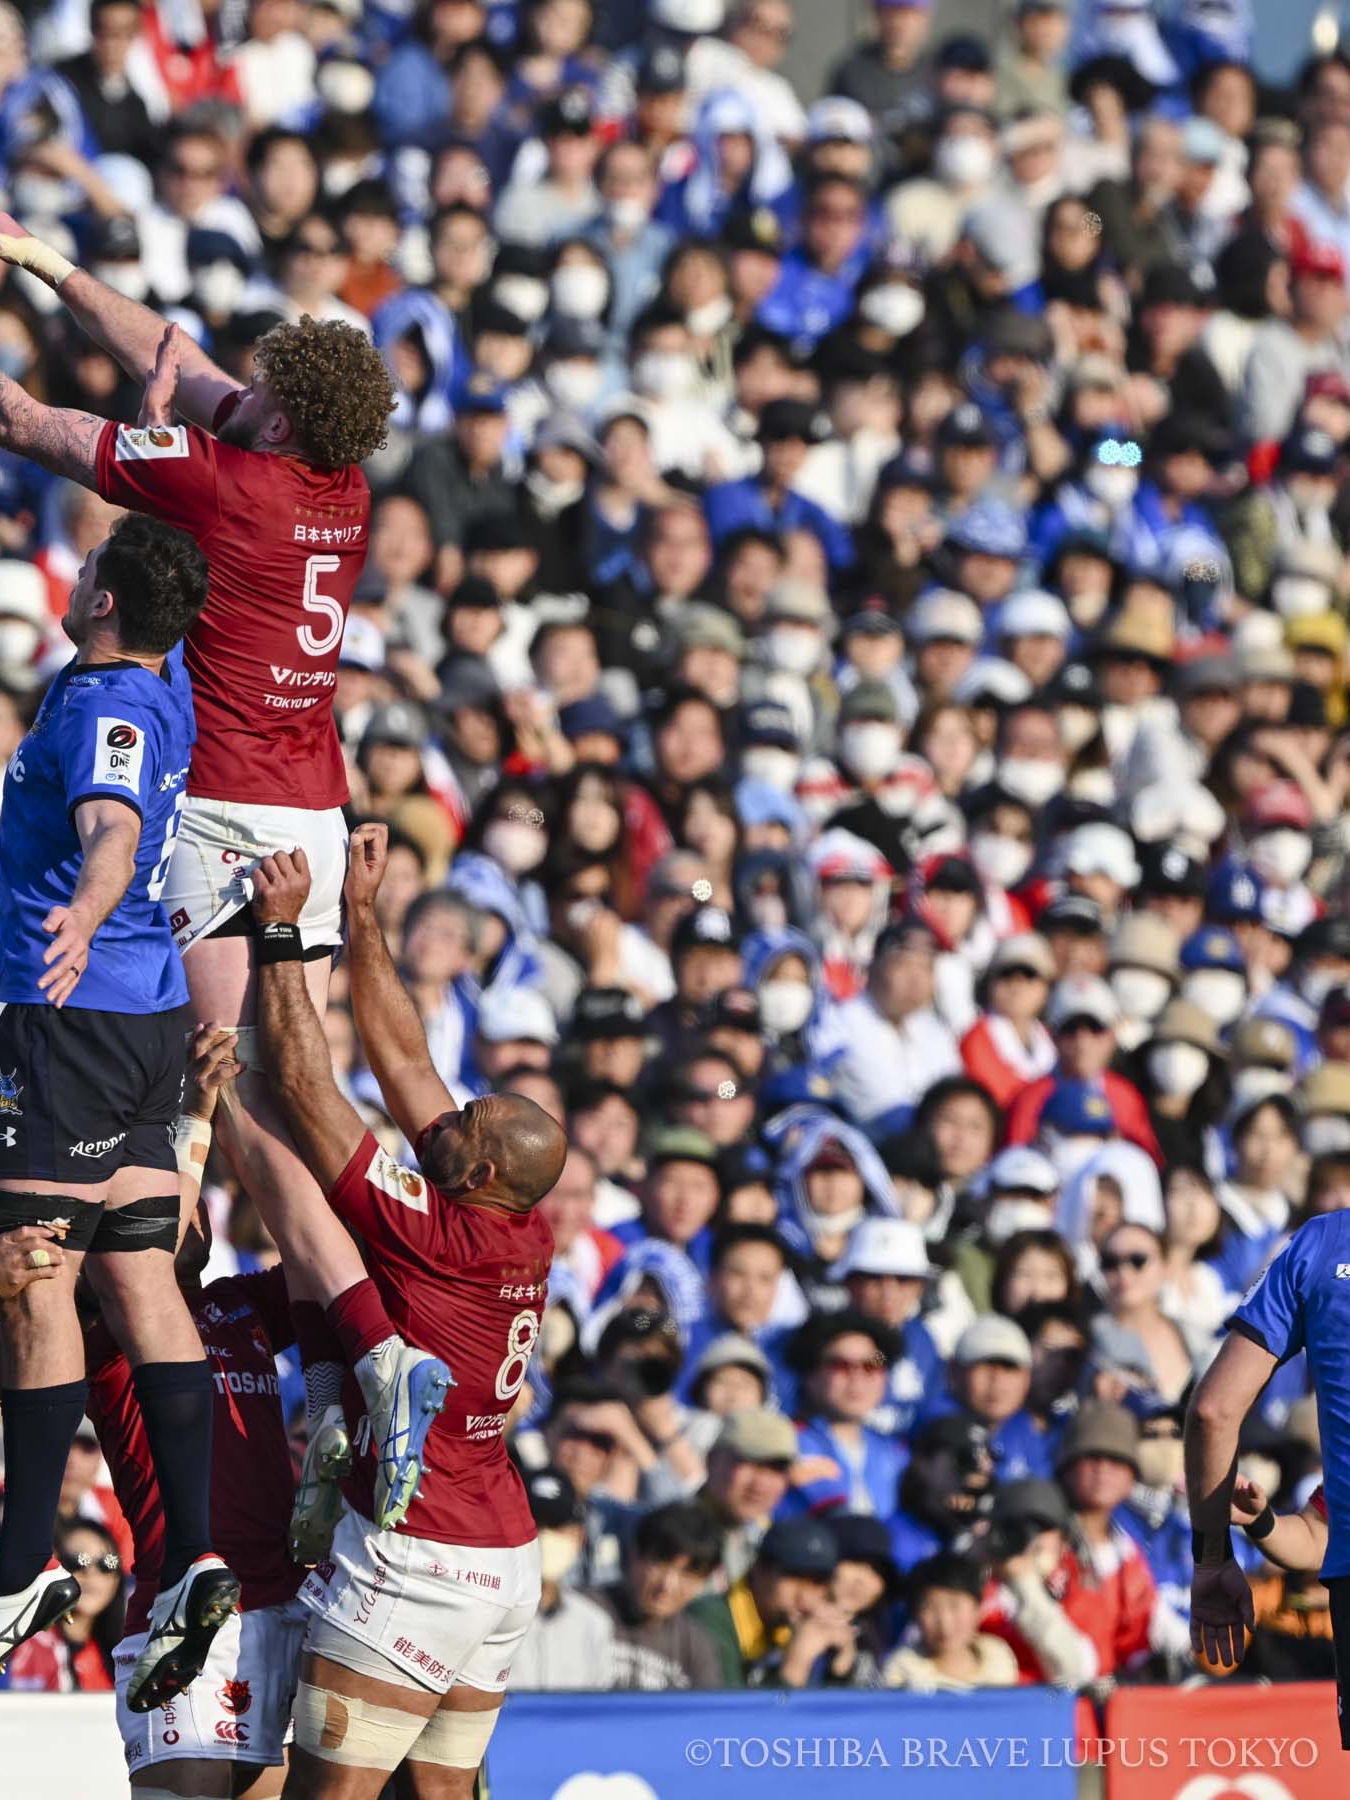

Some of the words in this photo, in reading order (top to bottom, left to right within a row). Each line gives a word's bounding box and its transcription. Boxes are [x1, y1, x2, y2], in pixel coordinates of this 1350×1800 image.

[294, 524, 362, 544] 日本キャリア
[296, 555, 344, 656] 5
[495, 1309, 539, 1401] 8
